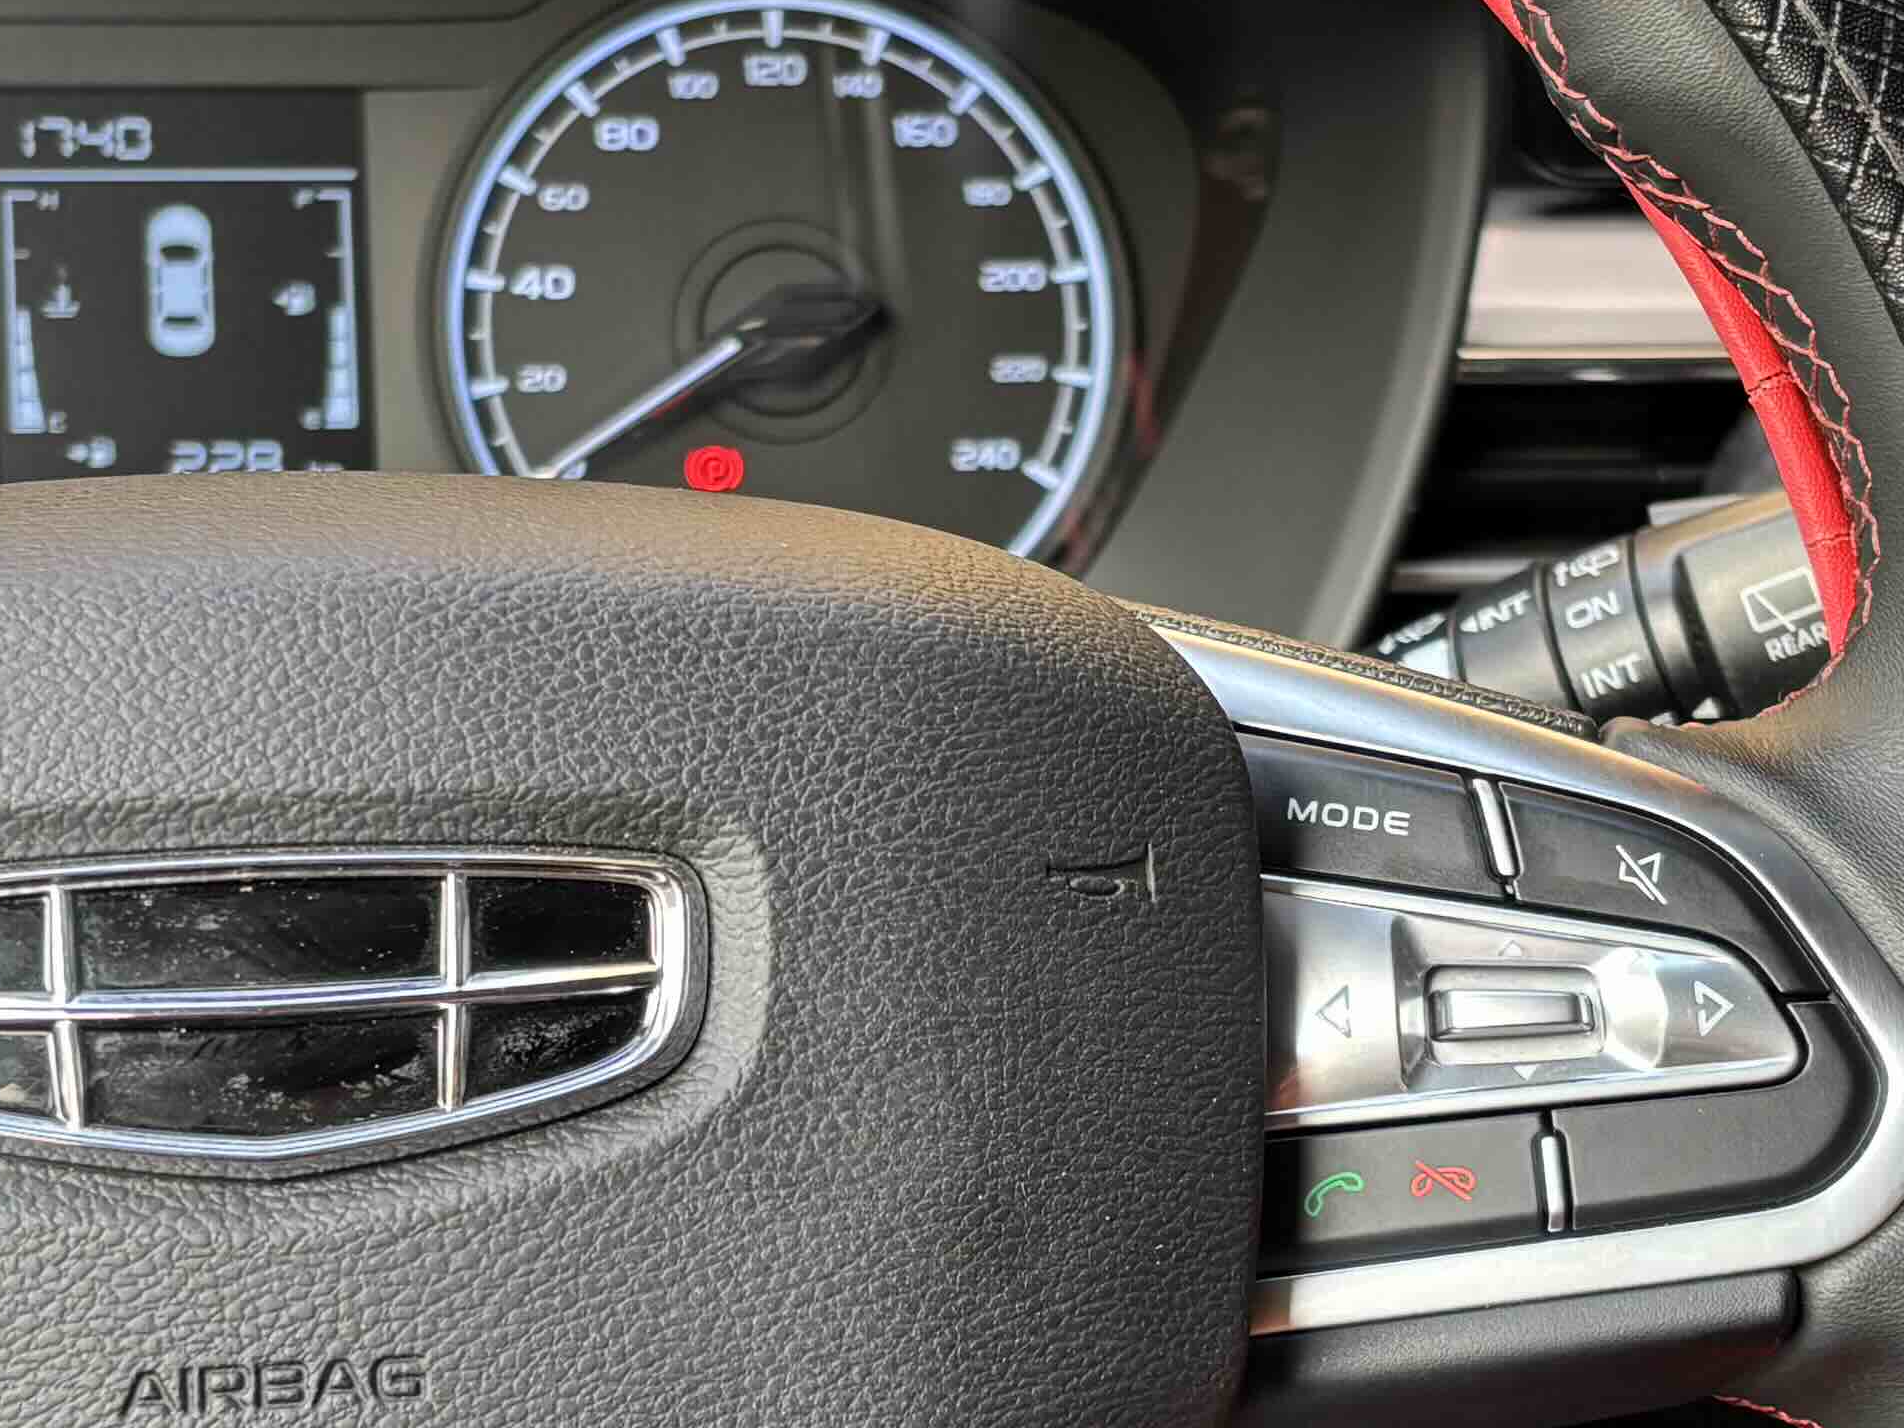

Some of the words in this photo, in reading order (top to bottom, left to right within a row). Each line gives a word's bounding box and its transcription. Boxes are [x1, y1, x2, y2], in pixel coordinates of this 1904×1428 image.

[667, 72, 720, 100] 100
[743, 55, 806, 86] 120
[594, 117, 661, 152] 80
[893, 115, 960, 148] 160
[537, 183, 591, 212] 60
[509, 267, 577, 301] 40
[978, 262, 1048, 294] 200
[515, 364, 568, 394] 20
[949, 439, 1022, 471] 240
[1565, 590, 1622, 629] ON
[1764, 624, 1828, 662] REAR
[1581, 651, 1644, 699] INT
[1286, 796, 1411, 837] MODE
[118, 1353, 429, 1417] AIRBAG
